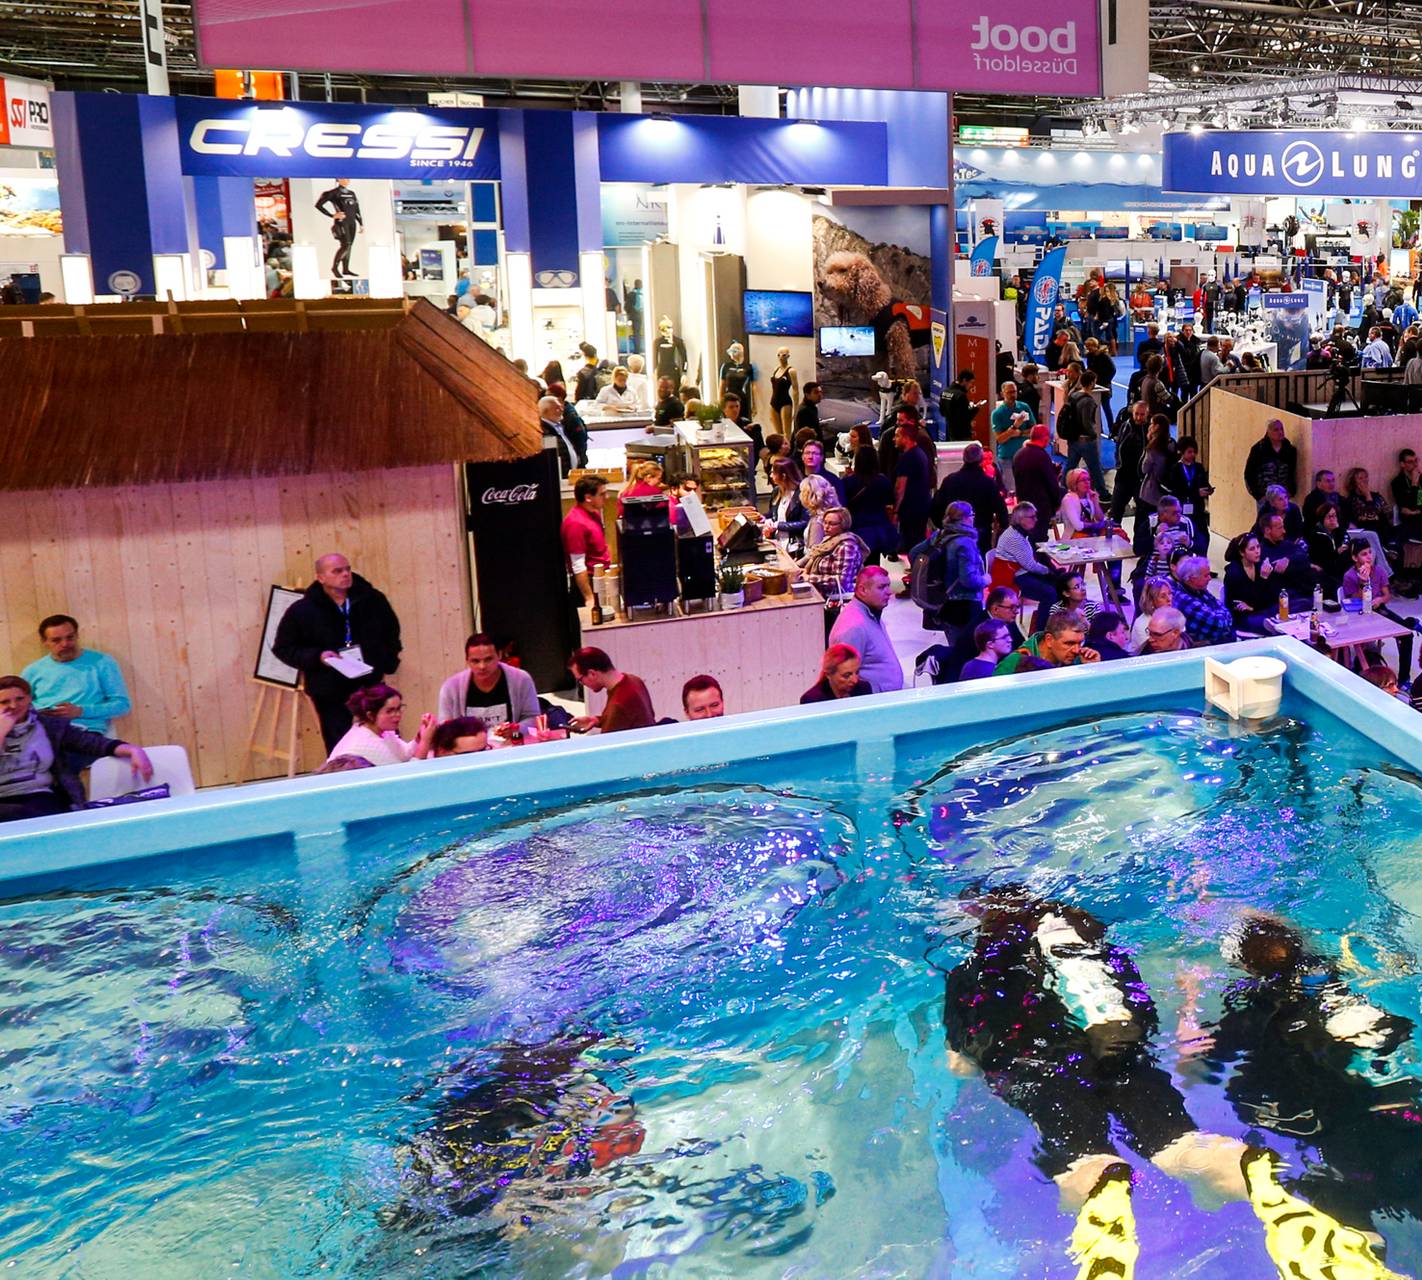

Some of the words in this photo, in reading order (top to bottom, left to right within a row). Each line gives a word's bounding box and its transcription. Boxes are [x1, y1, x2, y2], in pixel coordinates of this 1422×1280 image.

[29, 100, 49, 124] PRO
[189, 119, 485, 160] CRESSI
[1210, 151, 1275, 178] AQUA
[1332, 151, 1416, 178] LUNG
[1032, 306, 1052, 355] PADI
